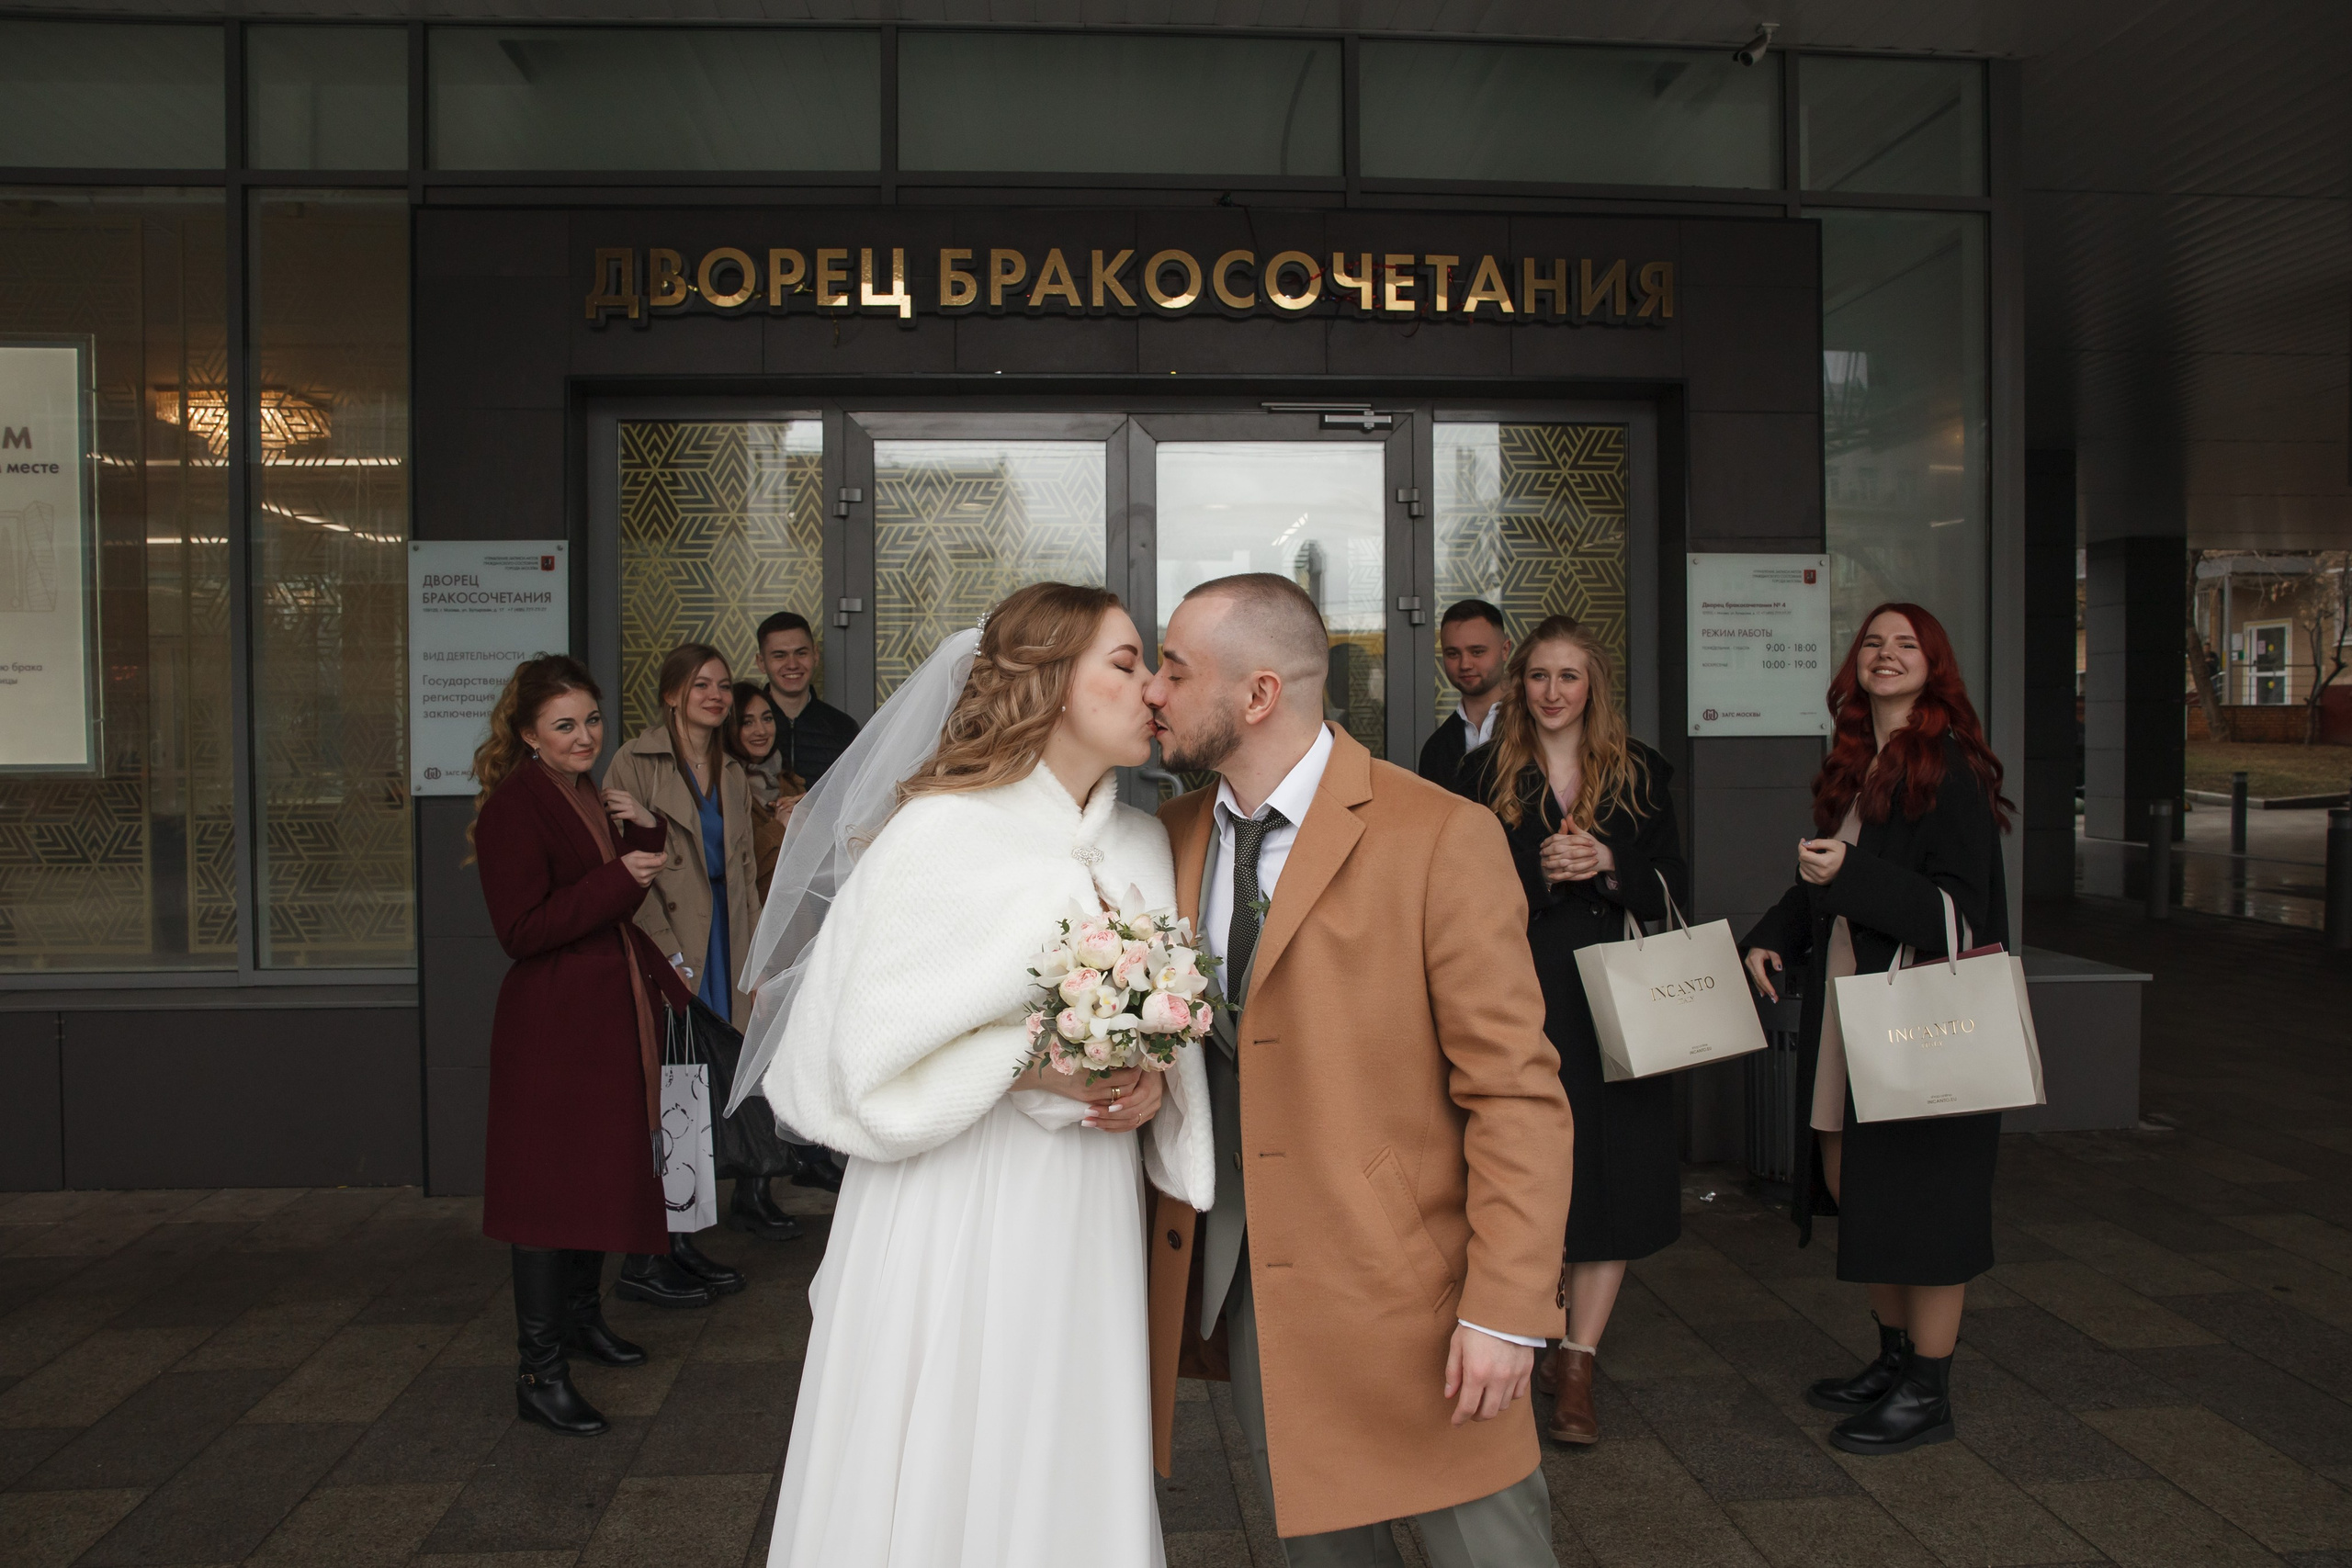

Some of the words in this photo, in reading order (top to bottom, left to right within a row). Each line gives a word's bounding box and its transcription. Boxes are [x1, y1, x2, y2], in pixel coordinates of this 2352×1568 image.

[585, 246, 911, 320] ДВОРЕЦ
[939, 247, 1674, 319] БРАКОСОЧЕТАНИЯ
[7, 463, 60, 474] месте
[423, 574, 480, 588] ДВОРЕЦ
[423, 592, 551, 604] БРАКОСОЧЕТАНИЯ
[1702, 629, 1735, 637] РЕЖИМ
[1738, 629, 1772, 637] РАБОТЫ
[1766, 643, 1785, 652] 9:00
[1794, 643, 1816, 652] 18:00
[423, 651, 445, 661] ВИД
[447, 651, 525, 661] ДЕЯТЕЛЬНОСТИ
[12, 662, 43, 673] брака
[1762, 660, 1785, 669] 10:00
[1794, 660, 1817, 669] 19:00
[423, 694, 495, 705] регистрация
[1649, 976, 1715, 1001] INCANTO
[1888, 1018, 1975, 1043] INCANTO
